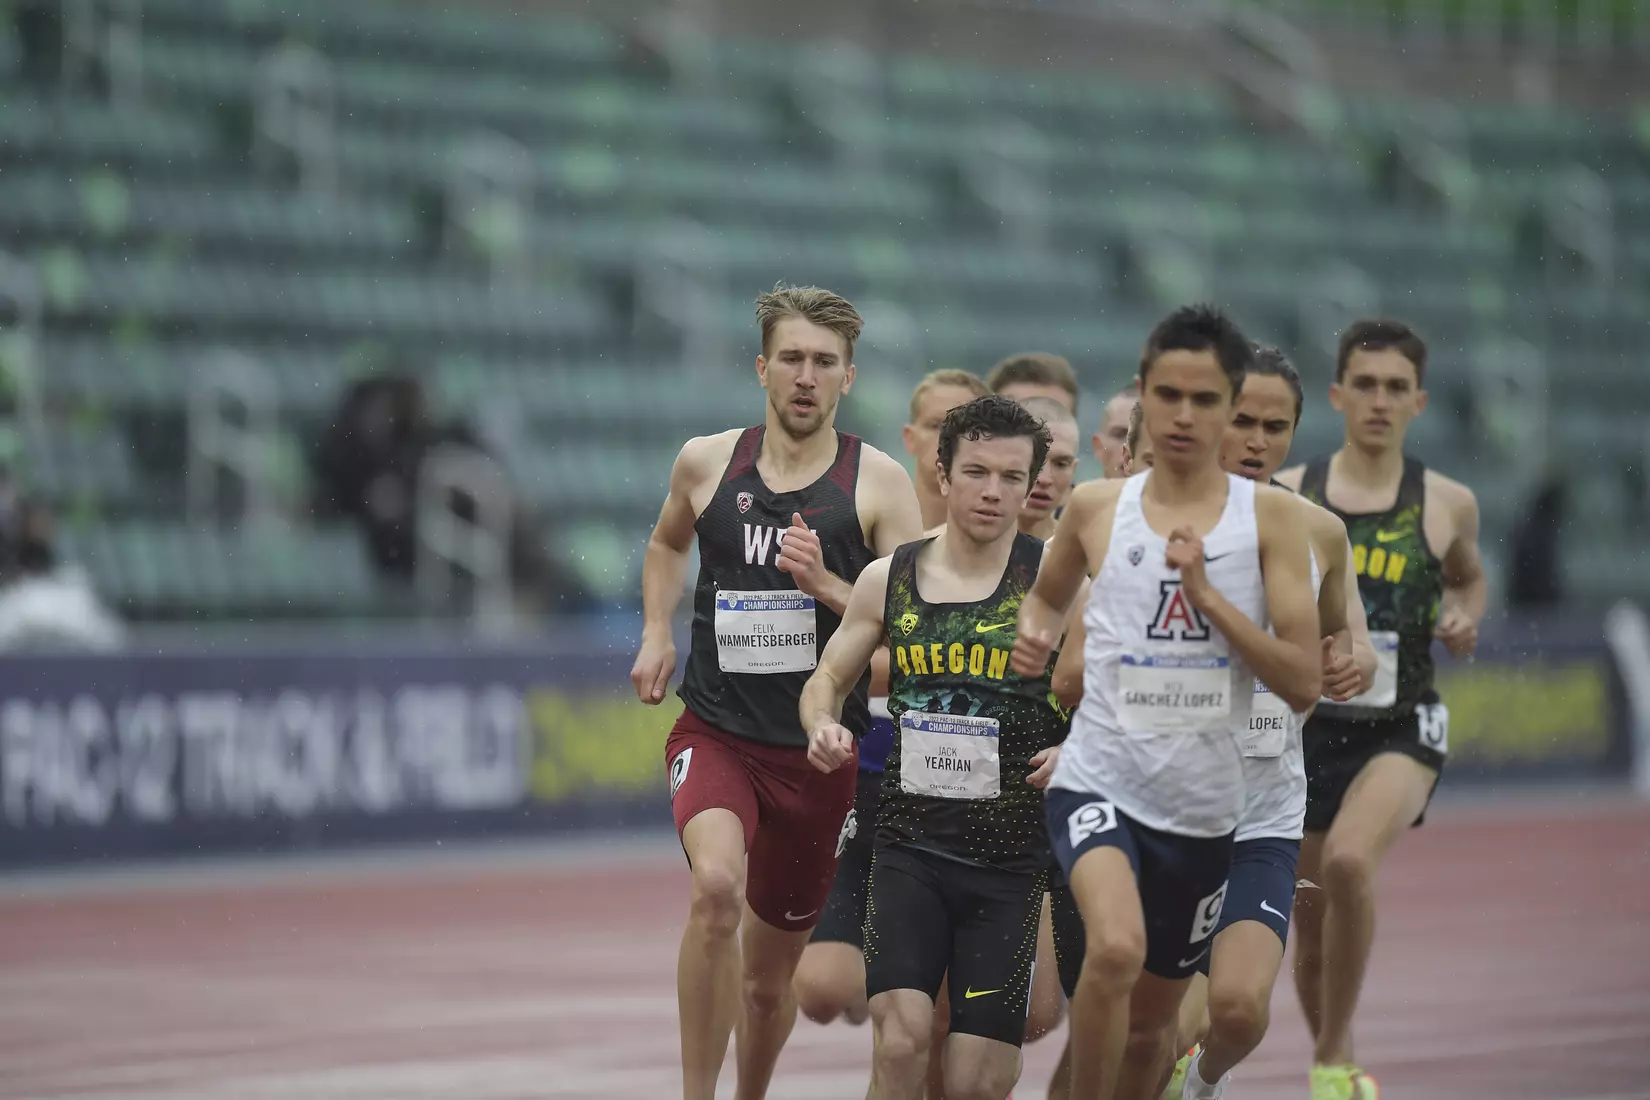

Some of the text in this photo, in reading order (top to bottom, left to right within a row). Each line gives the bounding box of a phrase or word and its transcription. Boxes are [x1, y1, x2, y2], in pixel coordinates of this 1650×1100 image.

[743, 523, 817, 567] WS
[743, 600, 804, 610] CHAMPIONSHIPS
[1147, 580, 1210, 641] A
[753, 623, 775, 634] FELIX
[717, 633, 815, 648] WAMMETSBERGER
[896, 642, 1009, 680] OREGON
[1184, 692, 1223, 708] LOPEZ
[928, 722, 988, 736] CHAMPIONSHIPS
[1249, 716, 1283, 731] LOPEZ
[938, 746, 958, 757] JACK
[924, 755, 971, 772] YEARIAN
[929, 783, 967, 791] OREGON
